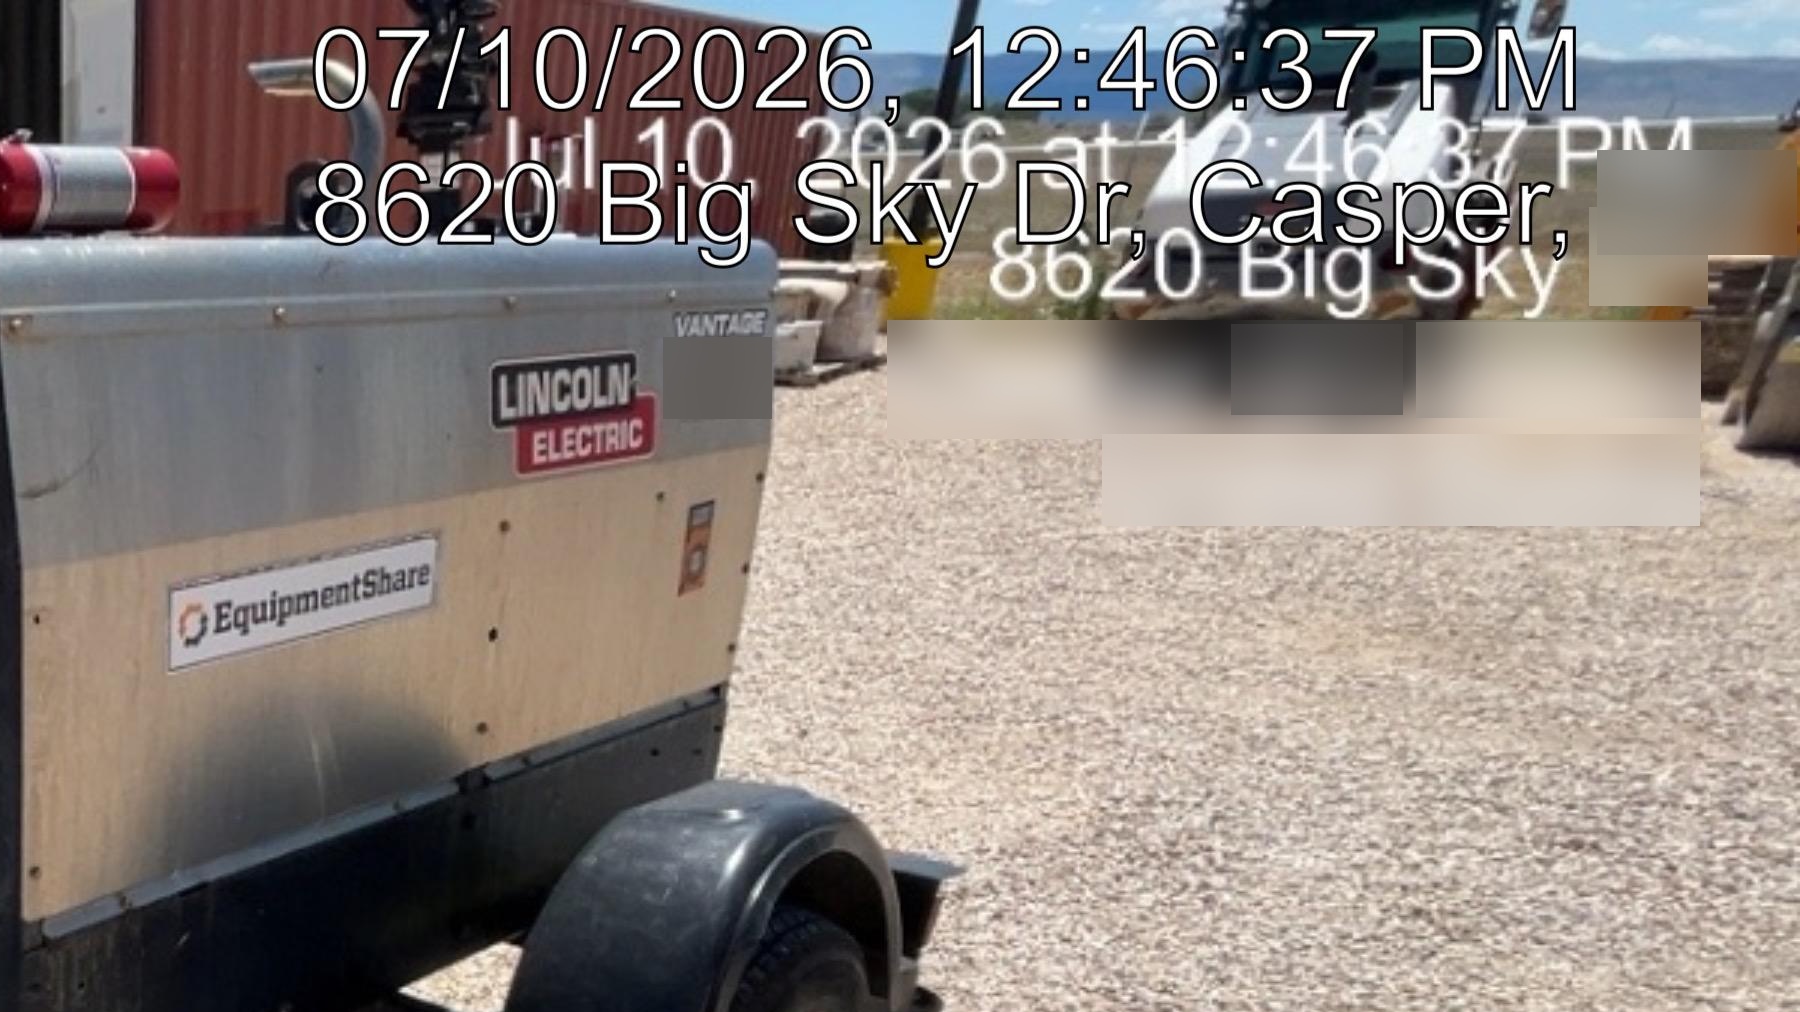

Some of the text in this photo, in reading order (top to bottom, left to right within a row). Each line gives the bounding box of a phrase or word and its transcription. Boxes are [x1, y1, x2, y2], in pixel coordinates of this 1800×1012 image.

[674, 312, 767, 337] VANTAGE
[500, 362, 631, 419] LINCOLN
[532, 418, 644, 466] ELECTRIC
[213, 563, 431, 635] EquipmentShare
